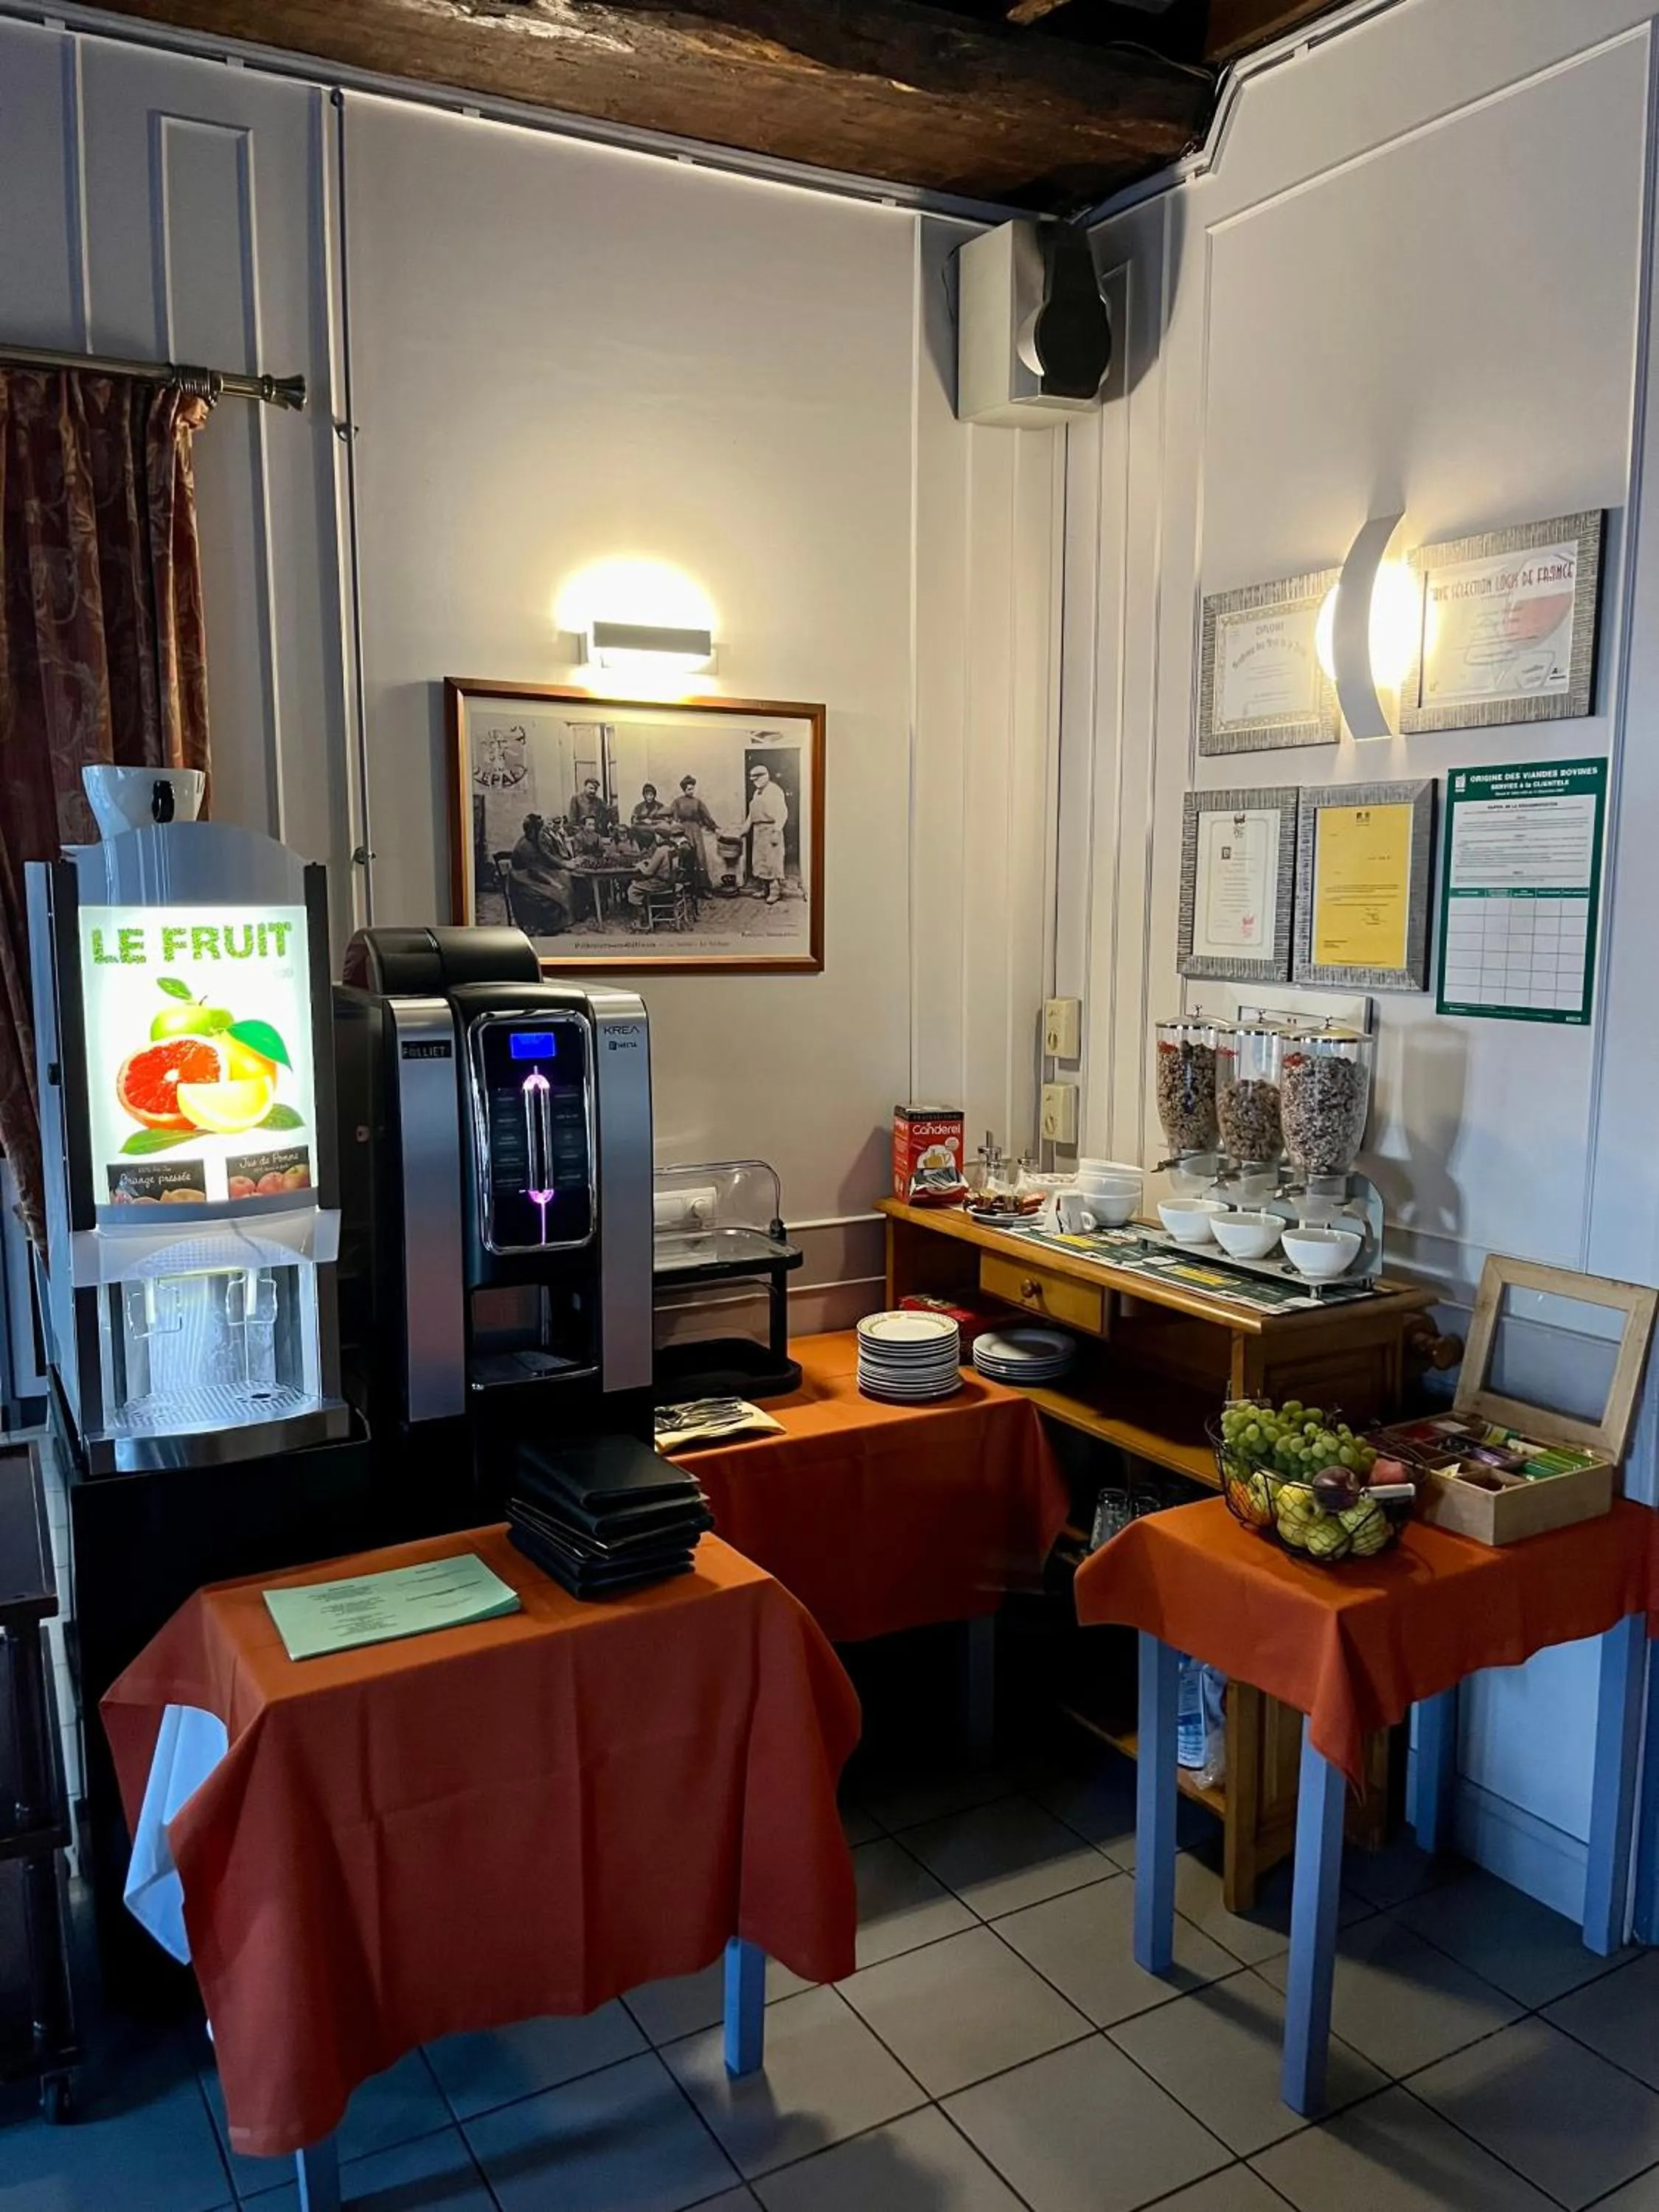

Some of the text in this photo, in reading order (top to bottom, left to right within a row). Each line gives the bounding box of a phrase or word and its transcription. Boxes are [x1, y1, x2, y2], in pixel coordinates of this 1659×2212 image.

[1522, 568, 1534, 586] DE
[1470, 767, 1599, 783] ORIGINE DES VIANDES BOVINES
[91, 921, 293, 964] LE FRUIT
[603, 1026, 640, 1034] KREA
[912, 1122, 961, 1135] Canderel
[240, 1156, 257, 1169] Jus
[260, 1155, 271, 1166] de
[119, 1173, 155, 1189] Orange
